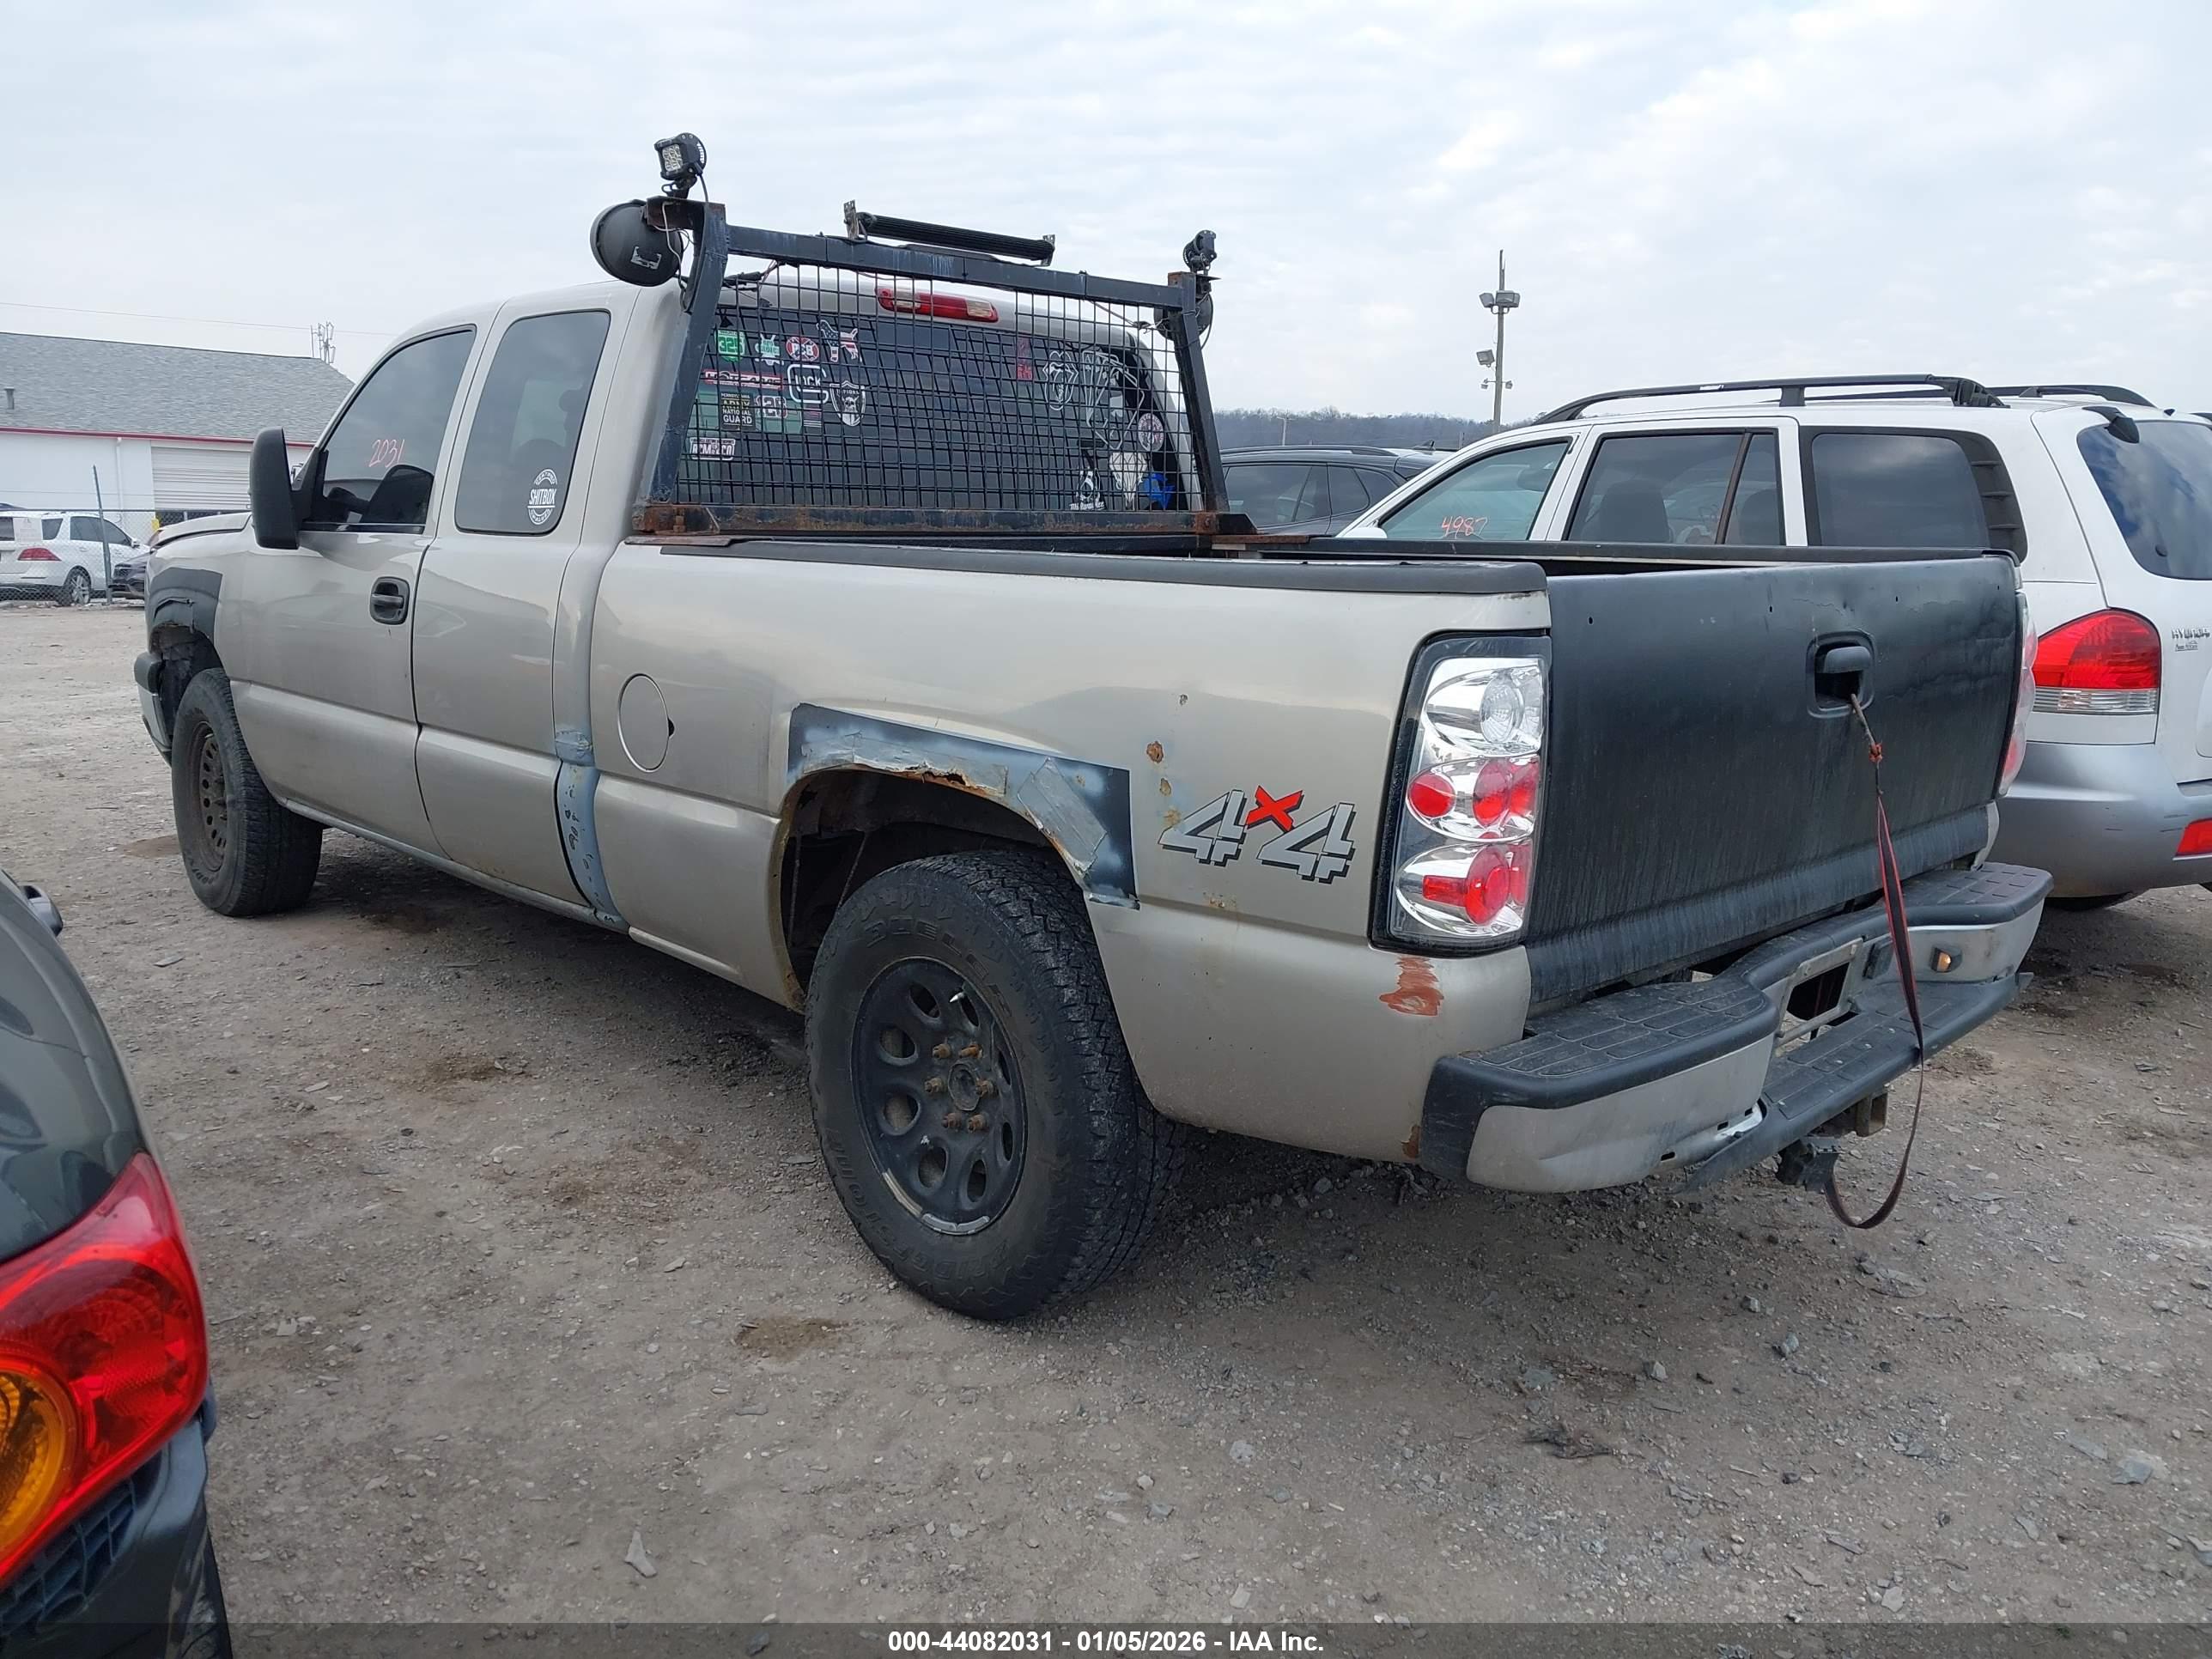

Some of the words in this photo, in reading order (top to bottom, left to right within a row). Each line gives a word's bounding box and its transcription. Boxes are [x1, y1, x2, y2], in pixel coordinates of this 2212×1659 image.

[722, 408, 751, 416] NATIONAL
[723, 415, 752, 424] GUARD
[368, 439, 405, 468] 2031
[529, 488, 556, 505] SHITBOX
[1441, 515, 1489, 539] 4987
